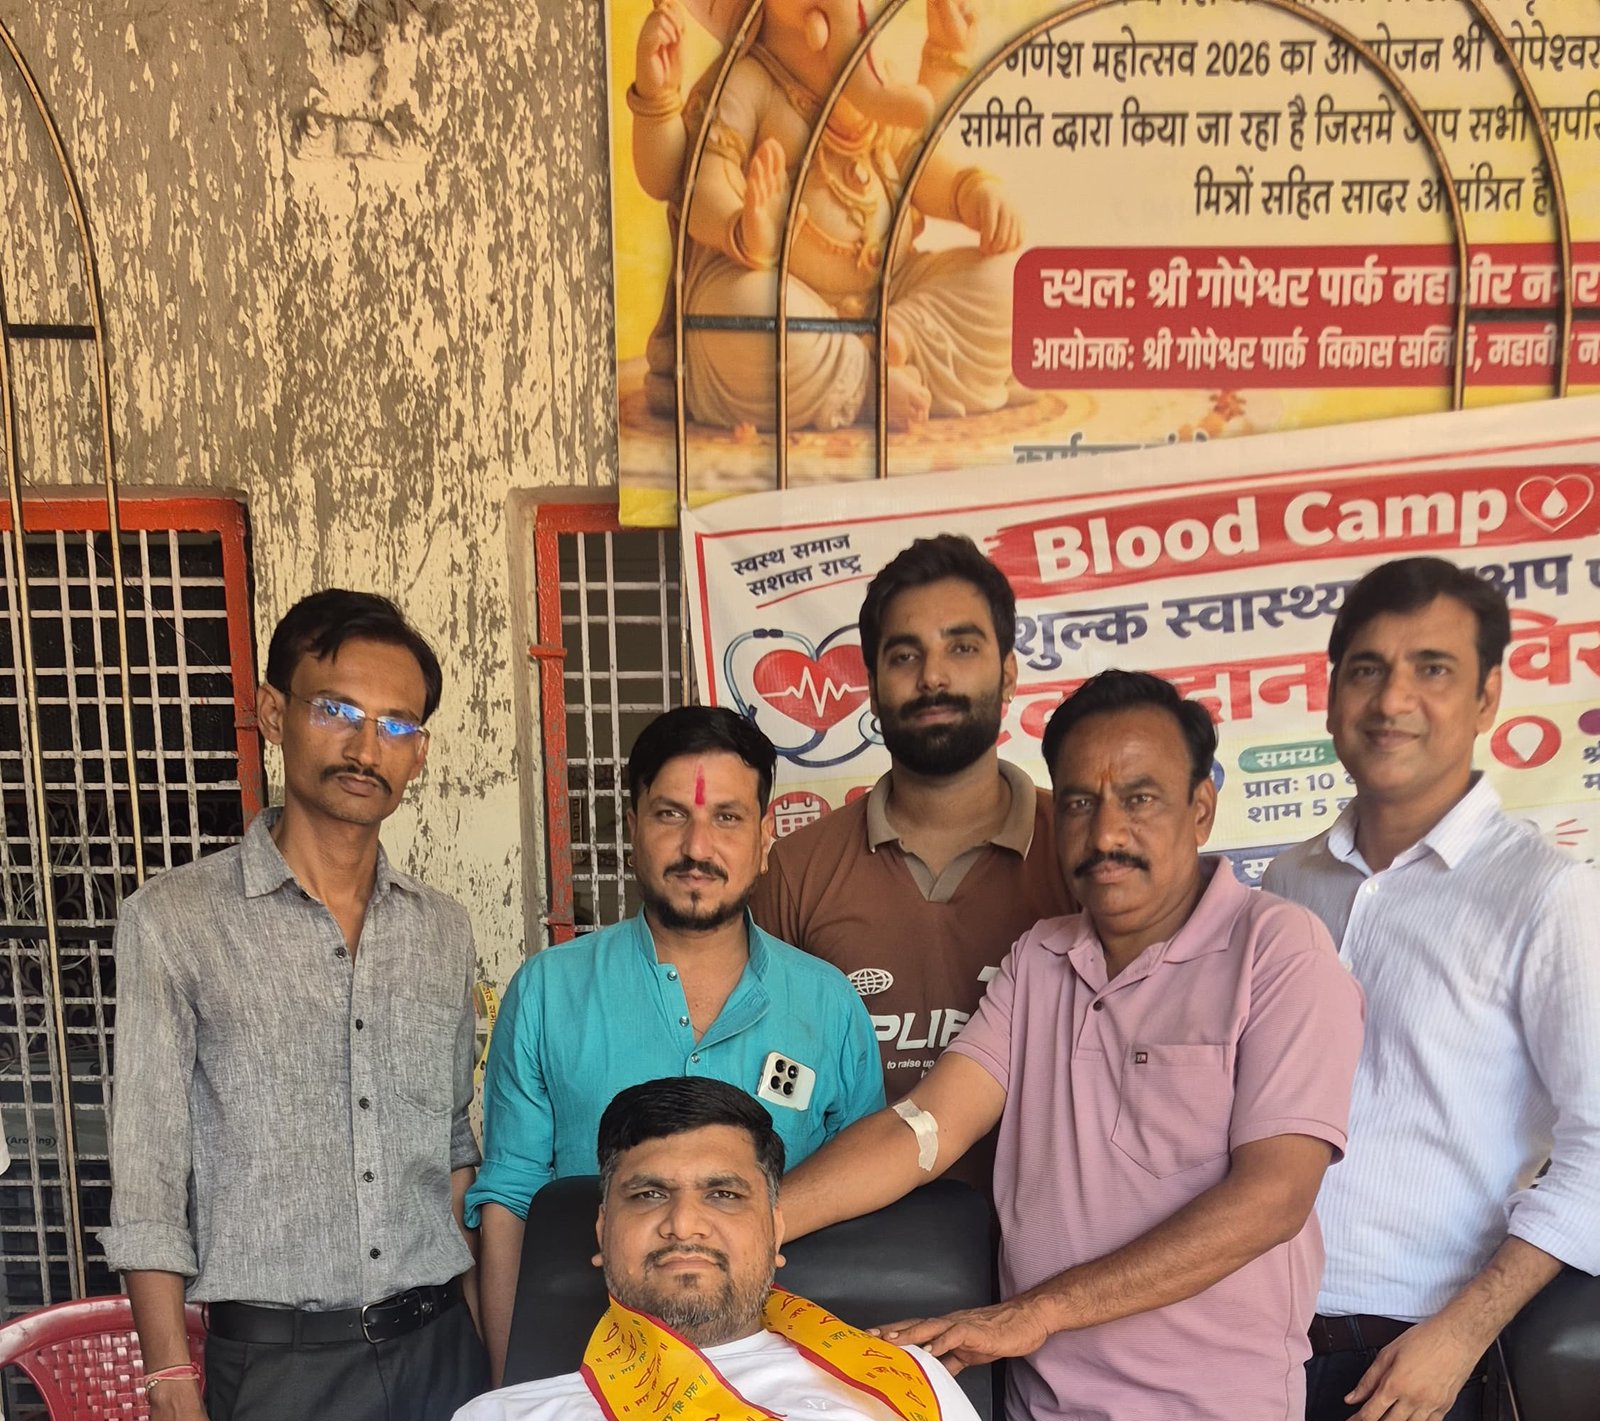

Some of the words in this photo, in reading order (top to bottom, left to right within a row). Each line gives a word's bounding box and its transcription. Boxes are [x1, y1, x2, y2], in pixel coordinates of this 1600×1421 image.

[1092, 25, 1198, 82] महोत्सव
[1206, 41, 1270, 77] 2026
[1280, 40, 1316, 75] का
[1325, 22, 1443, 75] आोजन
[1453, 20, 1486, 73] श्री
[960, 97, 1044, 148] समिति
[1052, 113, 1113, 151] द्वारा
[1121, 96, 1189, 147] किया
[1196, 112, 1232, 146] जा
[1240, 112, 1281, 151] रहा
[1288, 95, 1307, 151] है
[1315, 94, 1395, 145] जिसमे
[1469, 93, 1533, 142] सभी
[1194, 165, 1254, 216] मित्रों
[1262, 164, 1334, 219] सहित
[1342, 179, 1409, 216] सादर
[1040, 268, 1136, 309] स्थल:
[1147, 256, 1192, 309] श्री
[1196, 256, 1314, 308] गोपेश्वर
[1318, 254, 1388, 307] पार्क
[1032, 327, 1134, 370] आयोजक:
[1143, 327, 1173, 370] श्री
[1176, 327, 1257, 370] गोपेश्वर
[1260, 326, 1308, 370] पार्क
[1318, 326, 1396, 369] विकास
[731, 549, 786, 576] स्वस्थ
[790, 534, 850, 559] समाज
[1032, 496, 1260, 583] Blood
[1283, 487, 1508, 546] Camp
[747, 566, 813, 596] सशक्त
[819, 555, 862, 575] राष्ट्र
[1306, 772, 1335, 791] 10
[1248, 802, 1303, 823] शाम
[1312, 799, 1328, 816] 5
[887, 1060, 896, 1070] to
[898, 1058, 921, 1069] raise
[922, 1059, 935, 1070] up
